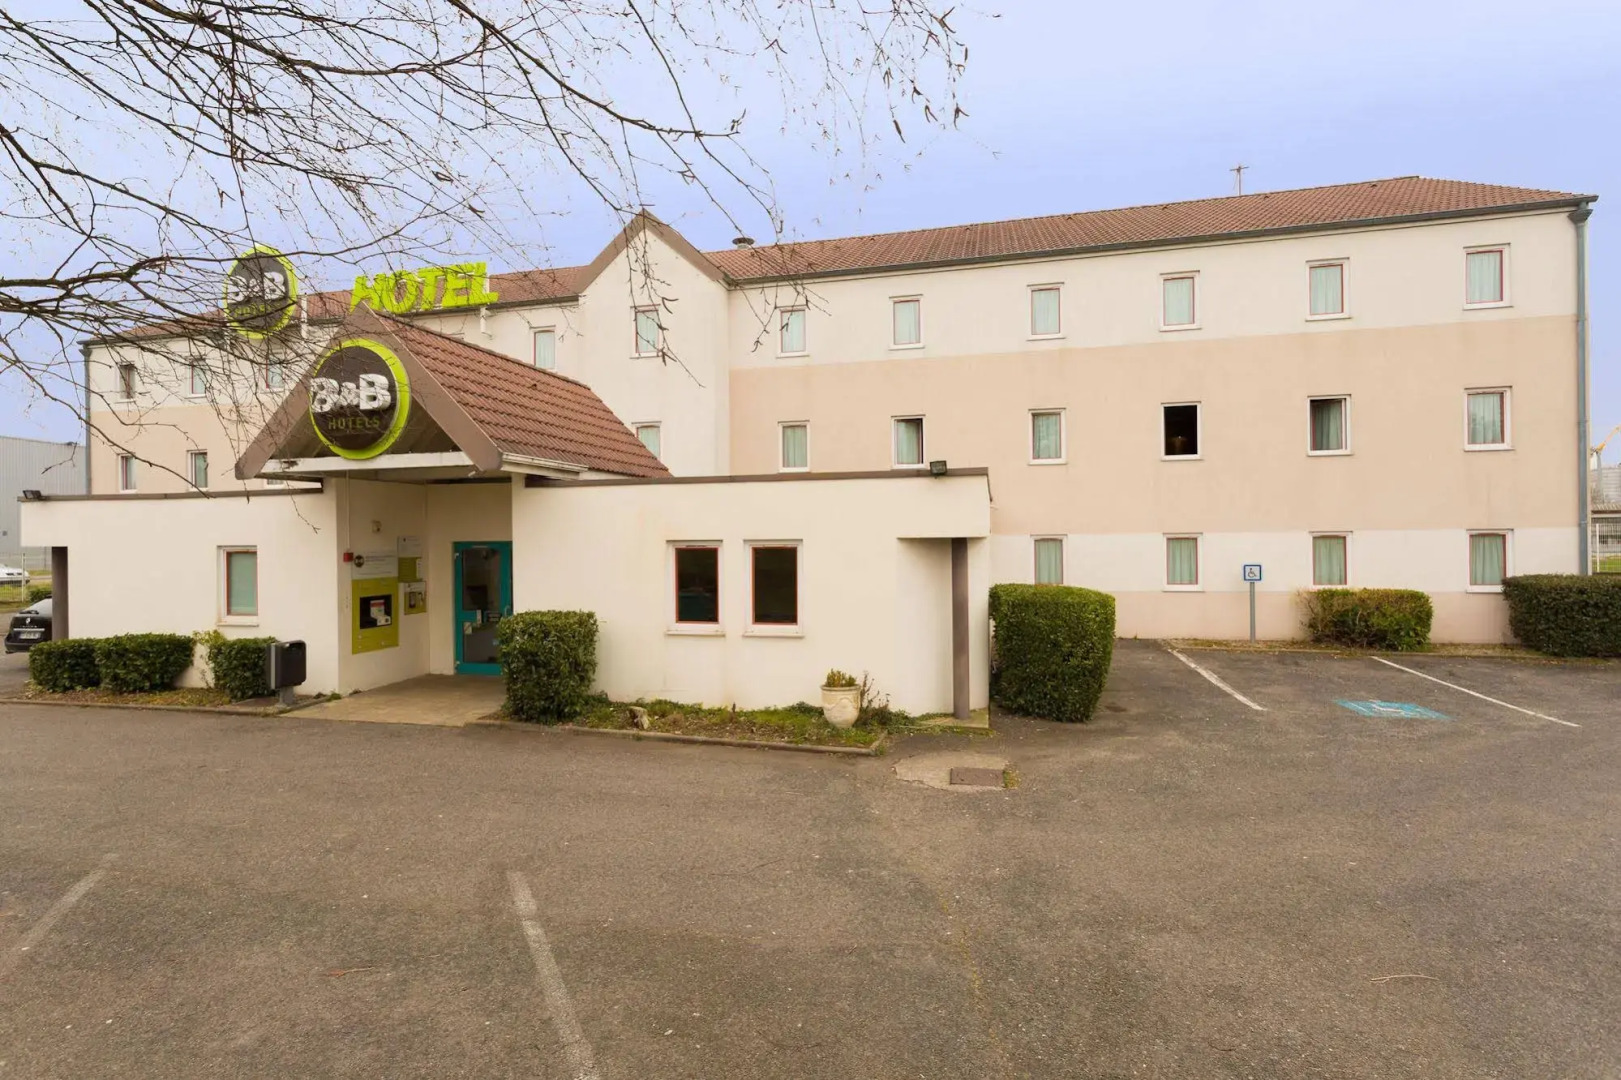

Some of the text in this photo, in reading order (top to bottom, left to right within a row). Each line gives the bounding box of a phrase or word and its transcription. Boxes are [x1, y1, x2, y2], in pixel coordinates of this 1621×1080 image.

[350, 262, 499, 315] HOTEL
[310, 373, 391, 413] B&B
[328, 416, 380, 430] HOTELS
